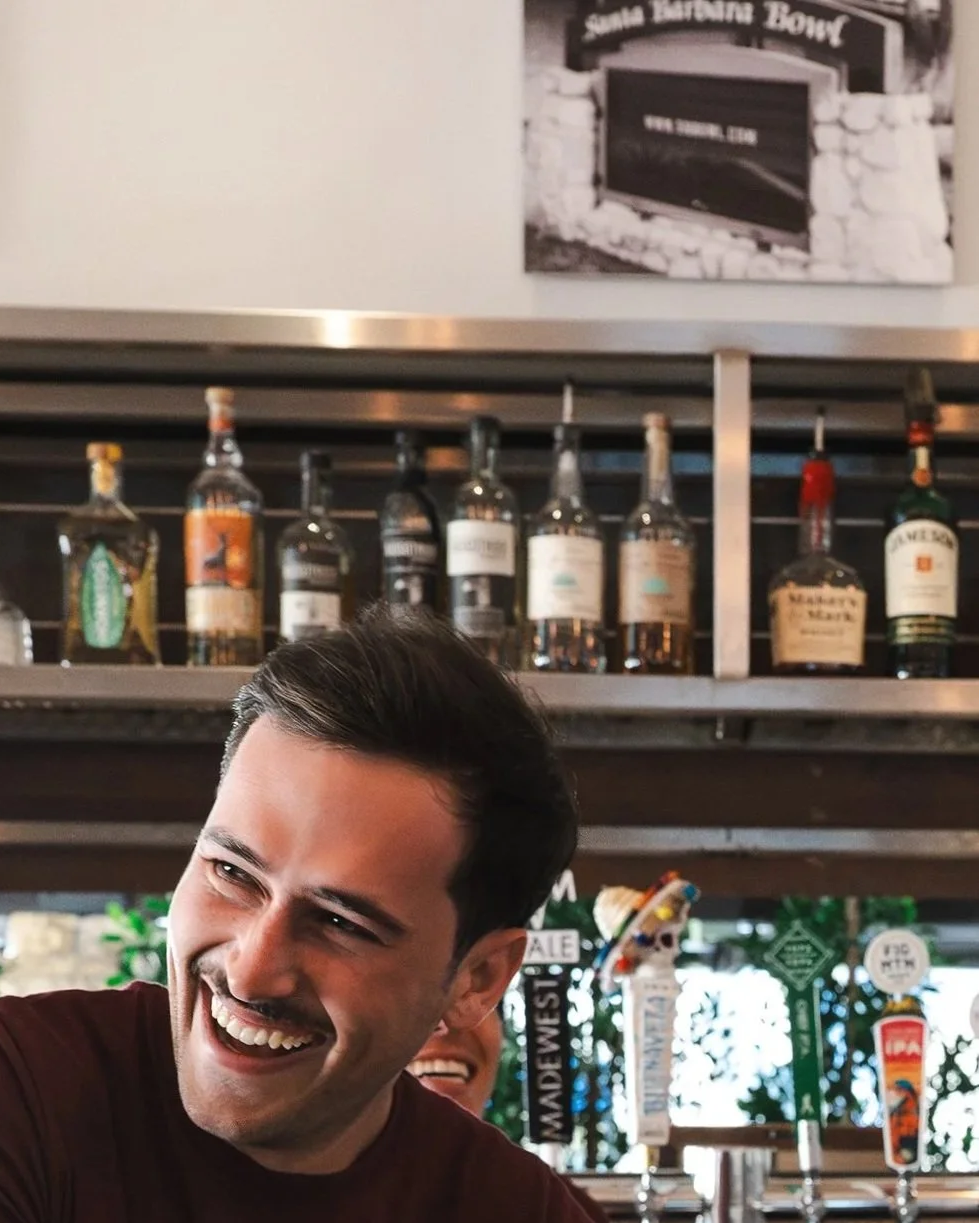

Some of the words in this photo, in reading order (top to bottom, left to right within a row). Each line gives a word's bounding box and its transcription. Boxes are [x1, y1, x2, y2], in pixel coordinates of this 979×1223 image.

[762, 1, 851, 47] Bowl
[526, 936, 574, 960] ALE
[532, 980, 562, 1142] MADEWEST
[885, 1039, 922, 1056] IPA
